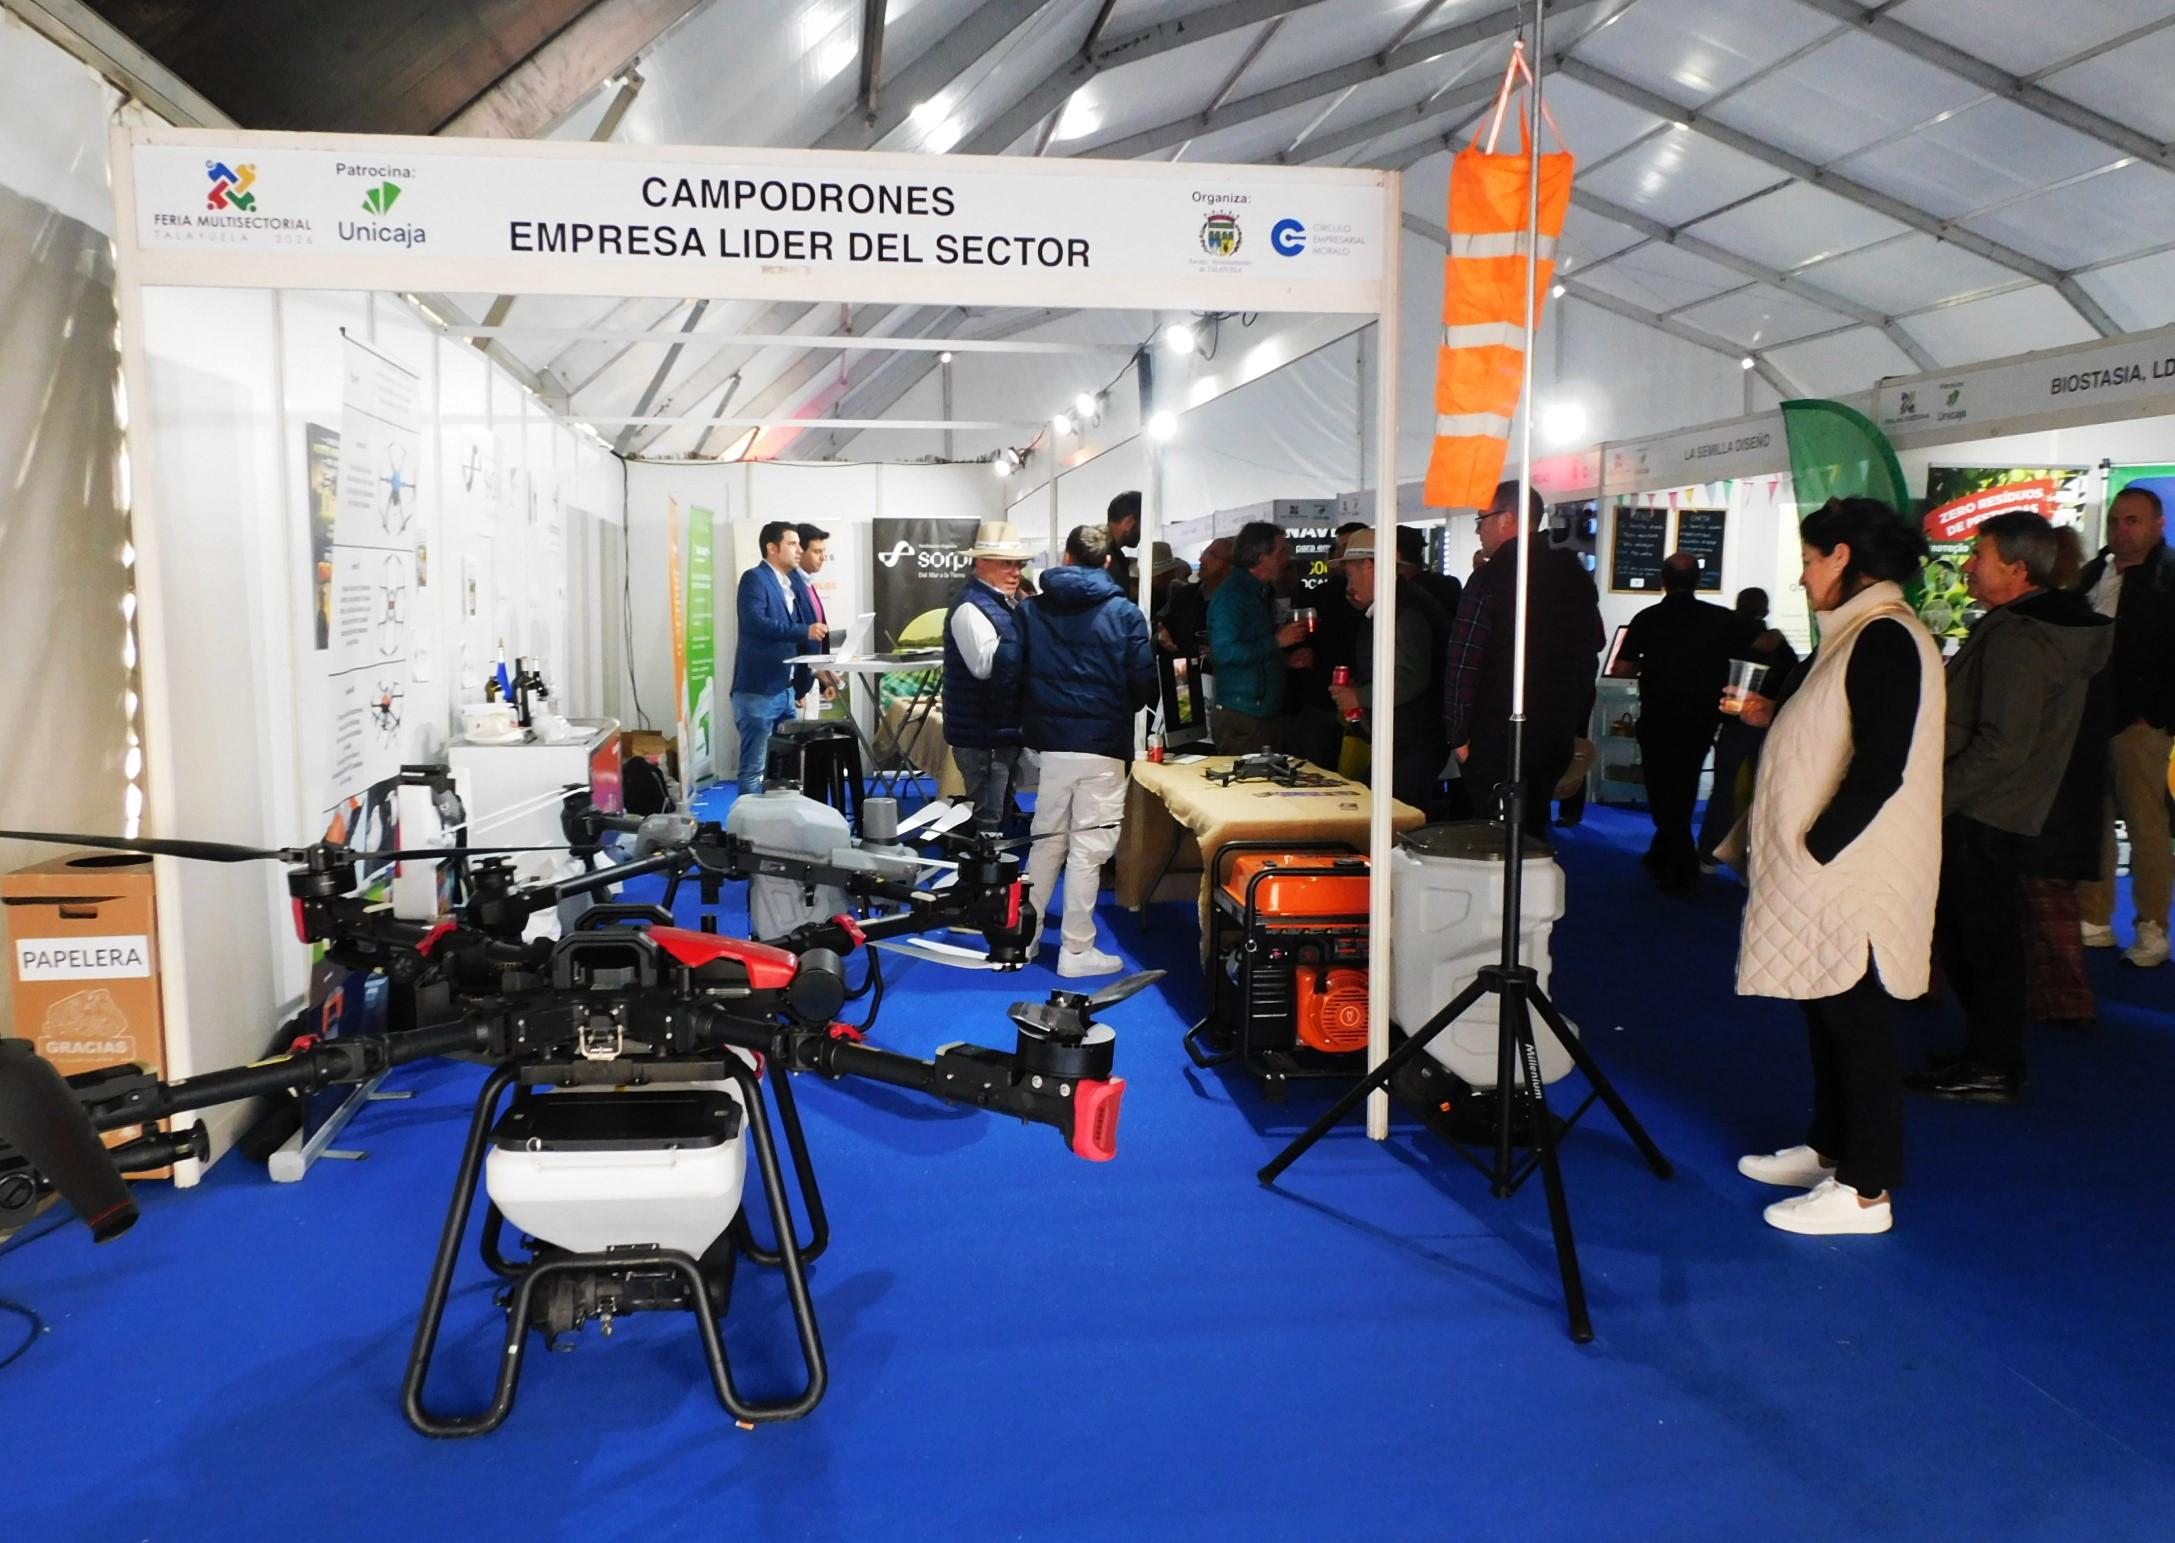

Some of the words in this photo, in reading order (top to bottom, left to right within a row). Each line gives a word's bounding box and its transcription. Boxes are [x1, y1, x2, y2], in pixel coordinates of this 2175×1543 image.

[336, 163, 416, 178] Patrocina:
[641, 177, 956, 216] CAMPODRONES
[1192, 191, 1251, 205] Organiza:
[154, 214, 192, 226] FERIA
[197, 216, 312, 230] MULTISECTORIAL
[154, 230, 248, 242] TALAYUELA
[338, 221, 426, 249] Unicaja
[1312, 235, 1366, 245] EMPRESARIAL
[509, 221, 707, 258] EMPRESA
[719, 228, 834, 261] LIDER
[848, 231, 923, 263] DEL
[934, 234, 1091, 268] SECTOR
[1312, 246, 1351, 256] MORALO
[2050, 364, 2146, 395] BIOSTASIA,
[1684, 449, 1695, 461] LA
[1697, 443, 1733, 459] SEMILLA
[1735, 432, 1771, 452] DISEÑO
[1938, 502, 1976, 524] ZERO
[1946, 520, 1966, 536] DE
[23, 948, 143, 969] PAPELERA
[45, 1041, 128, 1054] GRACIAS
[1524, 1043, 1542, 1099] Millenium
